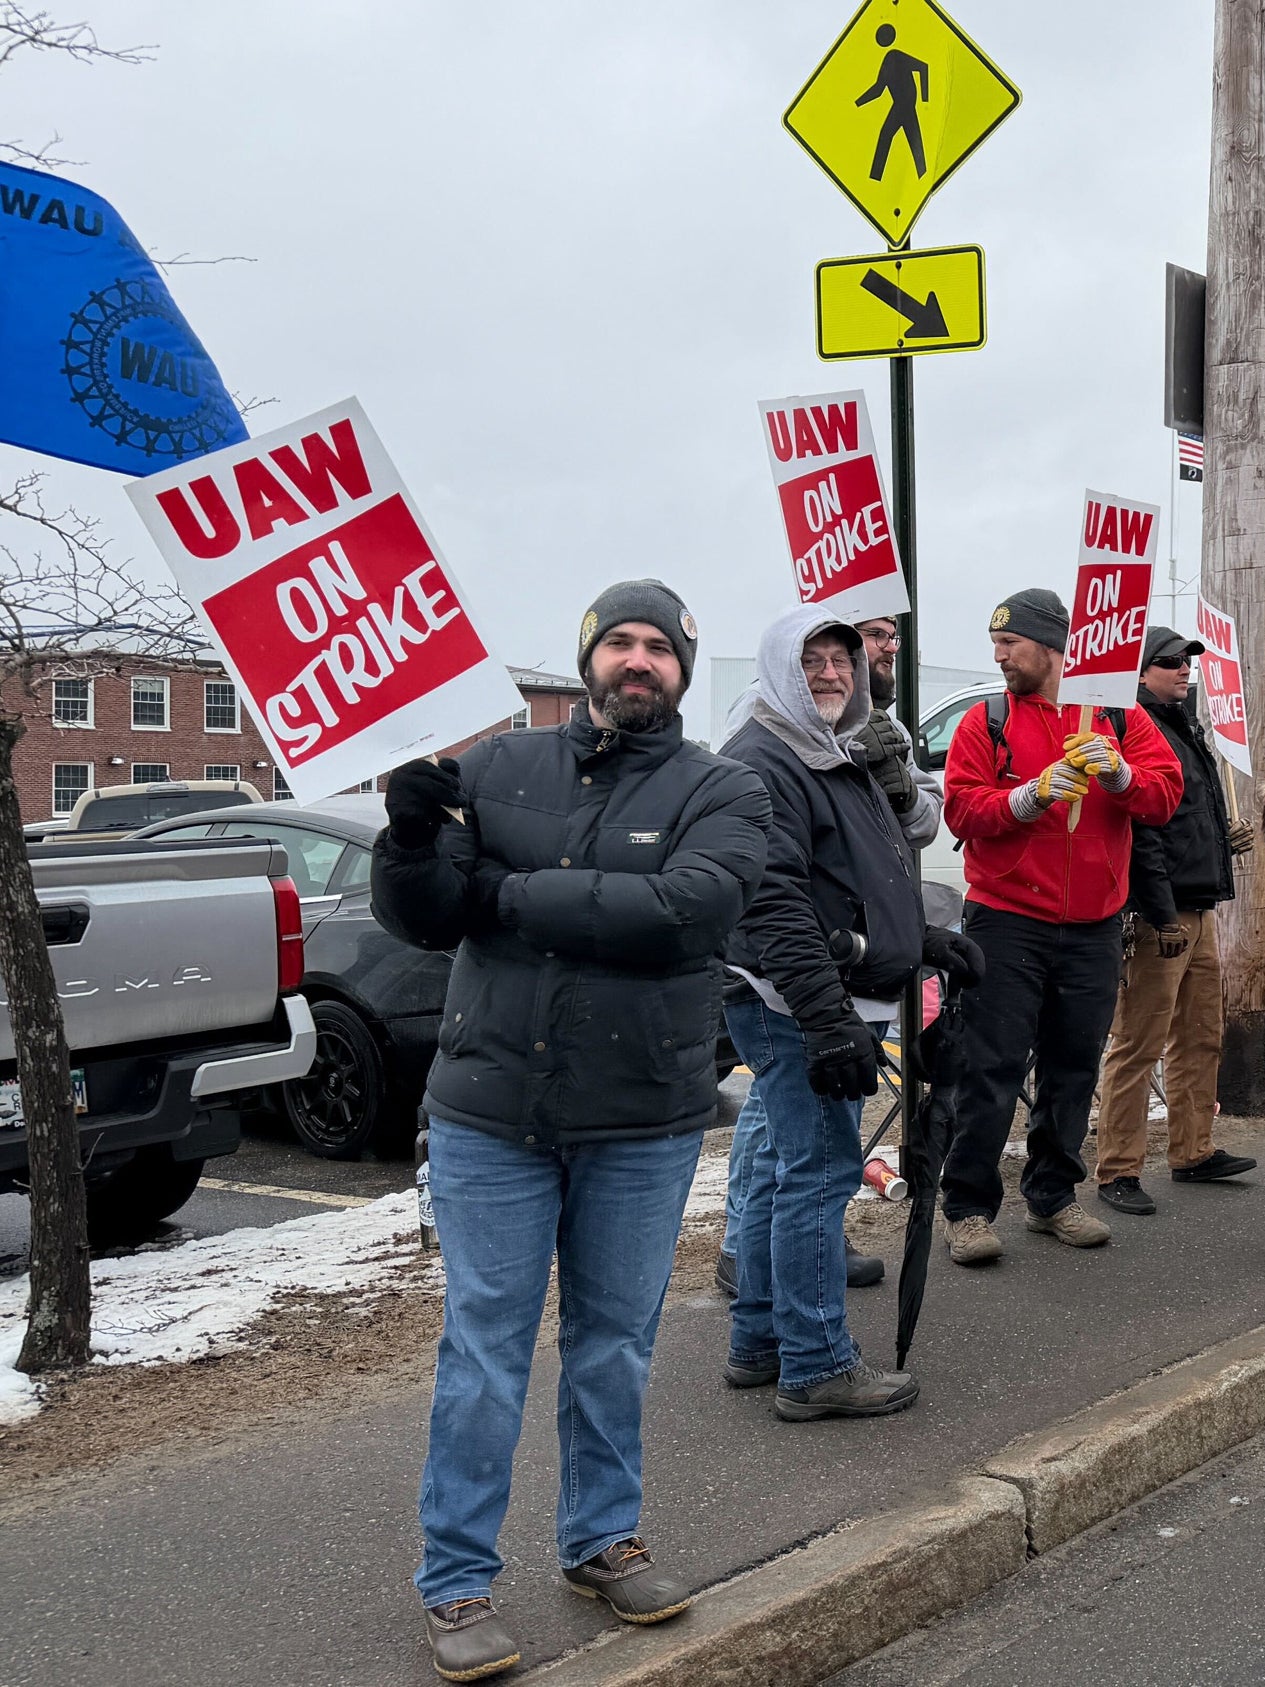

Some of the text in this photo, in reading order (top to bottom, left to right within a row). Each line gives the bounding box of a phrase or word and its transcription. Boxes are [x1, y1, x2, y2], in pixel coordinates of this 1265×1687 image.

[766, 401, 859, 463] UAW
[155, 418, 373, 560] UAW
[803, 472, 843, 533] ON
[795, 501, 889, 602] STRIKE
[1084, 500, 1154, 557] UAW
[276, 540, 367, 643] ON
[1086, 569, 1122, 617] ON
[1064, 606, 1146, 673] STRIKE
[1197, 600, 1232, 655] UAW
[265, 560, 461, 758] STRIKE
[1208, 660, 1225, 690] ON
[1208, 694, 1244, 726] STRIKE
